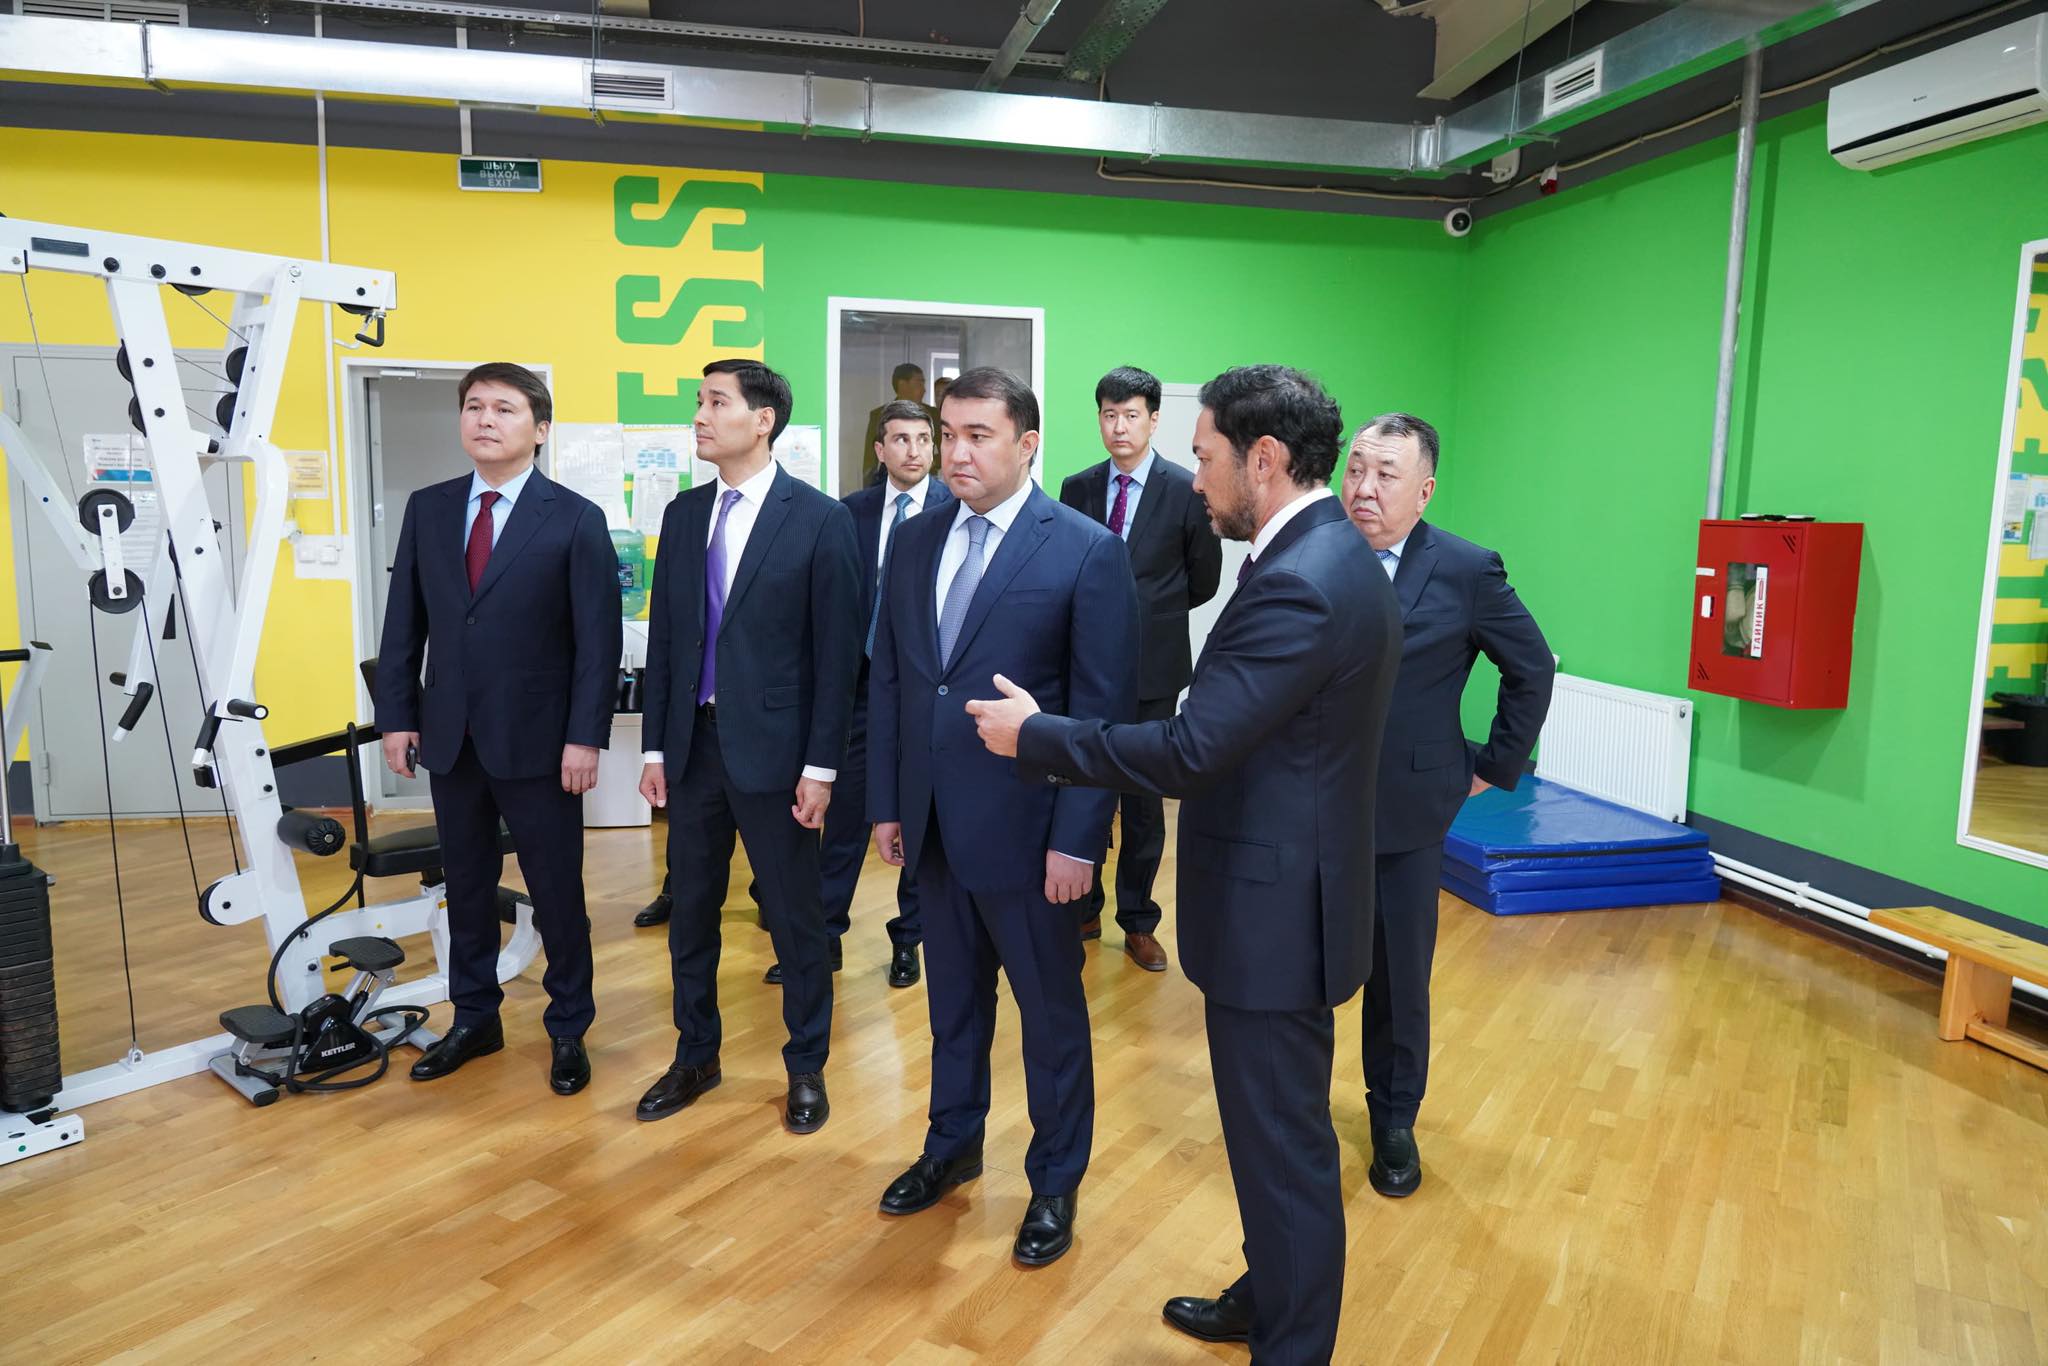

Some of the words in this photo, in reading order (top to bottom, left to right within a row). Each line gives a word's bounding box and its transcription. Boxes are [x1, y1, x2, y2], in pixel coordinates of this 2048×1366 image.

[480, 171, 520, 180] ВЫХОД
[488, 179, 512, 187] EXIT
[321, 1042, 356, 1057] KETTLER
